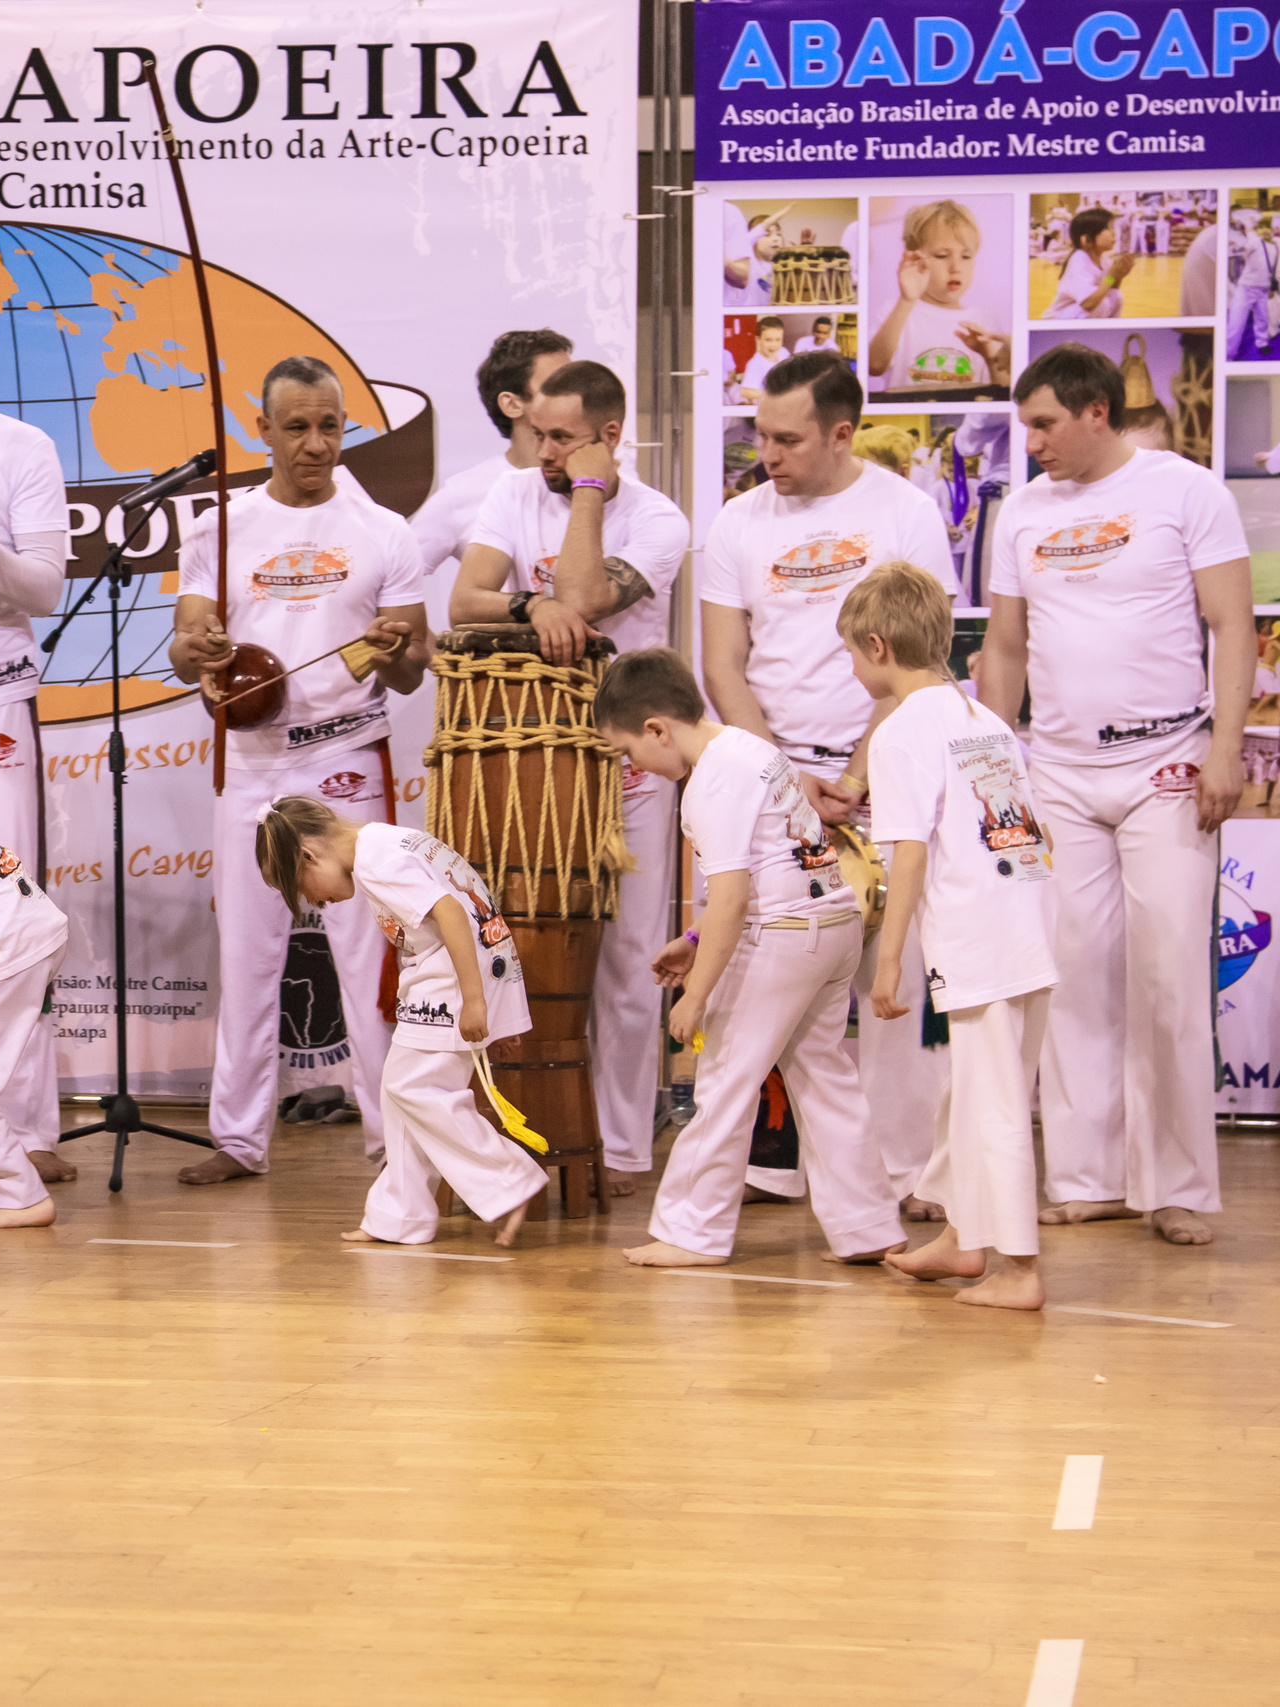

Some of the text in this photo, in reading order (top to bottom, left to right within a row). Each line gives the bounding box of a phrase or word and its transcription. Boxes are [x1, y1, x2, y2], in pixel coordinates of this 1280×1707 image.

[720, 103, 854, 130] Associação
[860, 98, 978, 123] Brasileira
[984, 97, 1015, 120] de
[1021, 95, 1099, 126] Apoio
[1105, 101, 1120, 117] e
[286, 128, 325, 160] da
[337, 126, 590, 168] Arte-Capoeira
[720, 129, 1206, 163] Presidente Fundador: Mestre Camisa
[128, 845, 214, 879] Cang
[96, 976, 148, 991] Metre
[152, 977, 208, 992] Camisa
[51, 1003, 109, 1018] ерация
